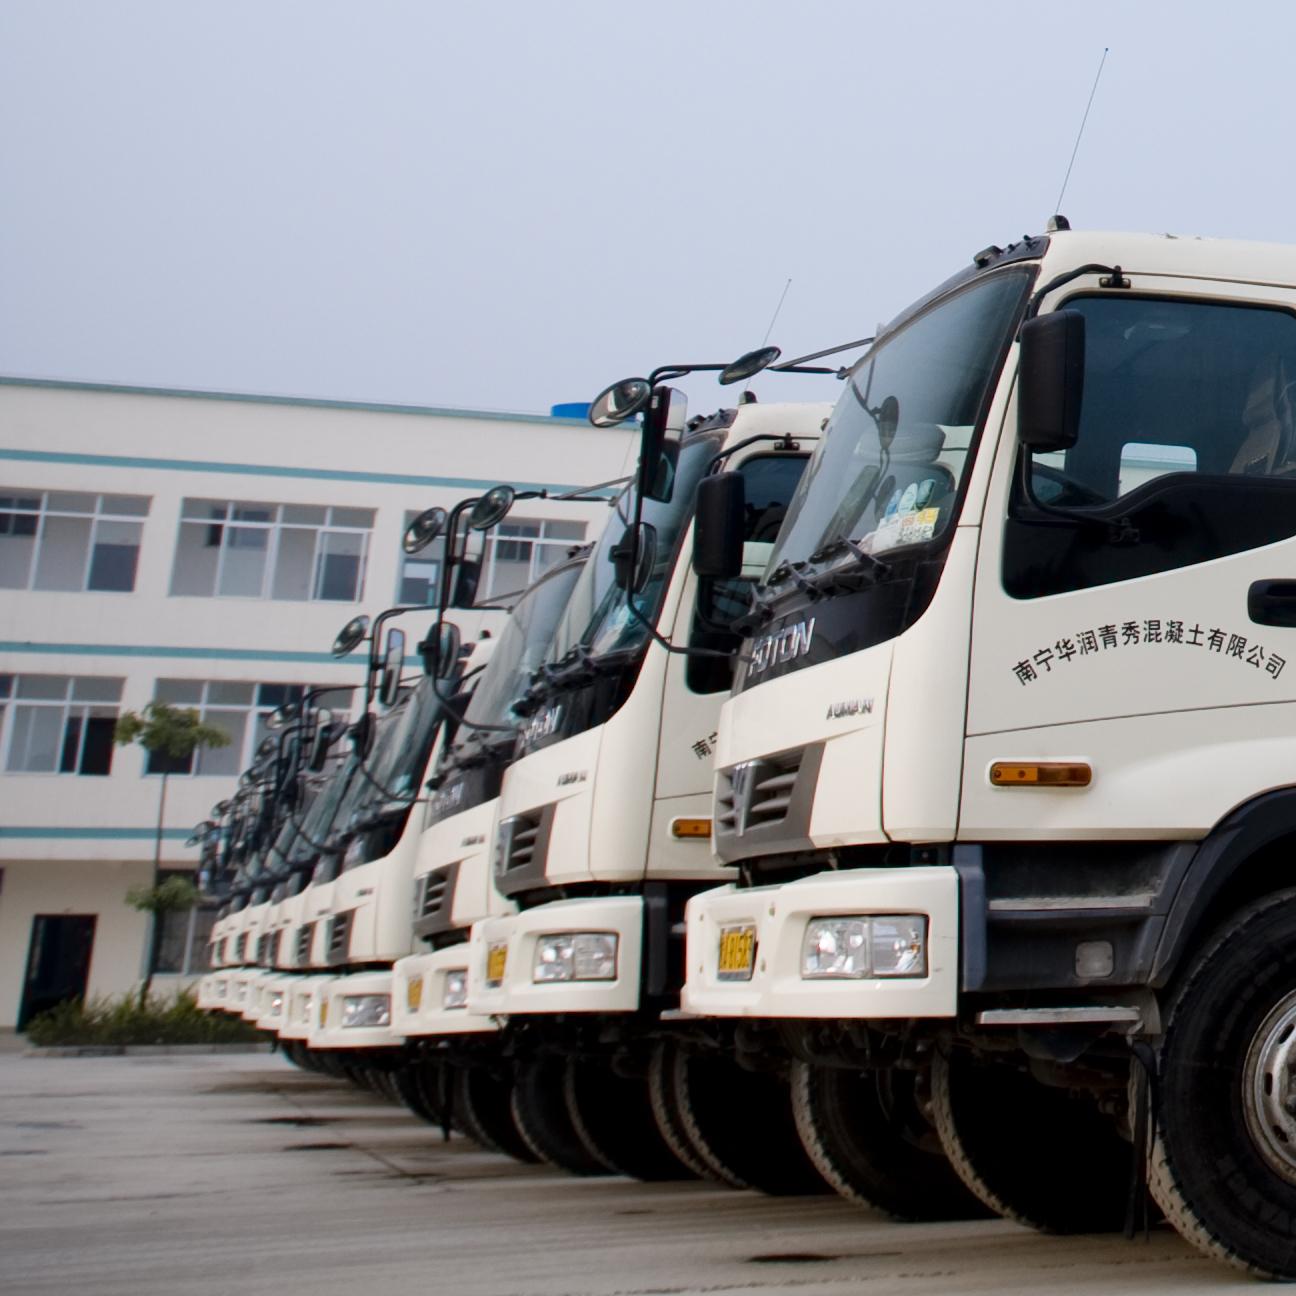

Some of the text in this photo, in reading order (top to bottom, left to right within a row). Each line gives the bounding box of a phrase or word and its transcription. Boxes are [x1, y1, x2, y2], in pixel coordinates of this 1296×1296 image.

[1012, 619, 1286, 686] 南宁华润青秀混凝土有限公司
